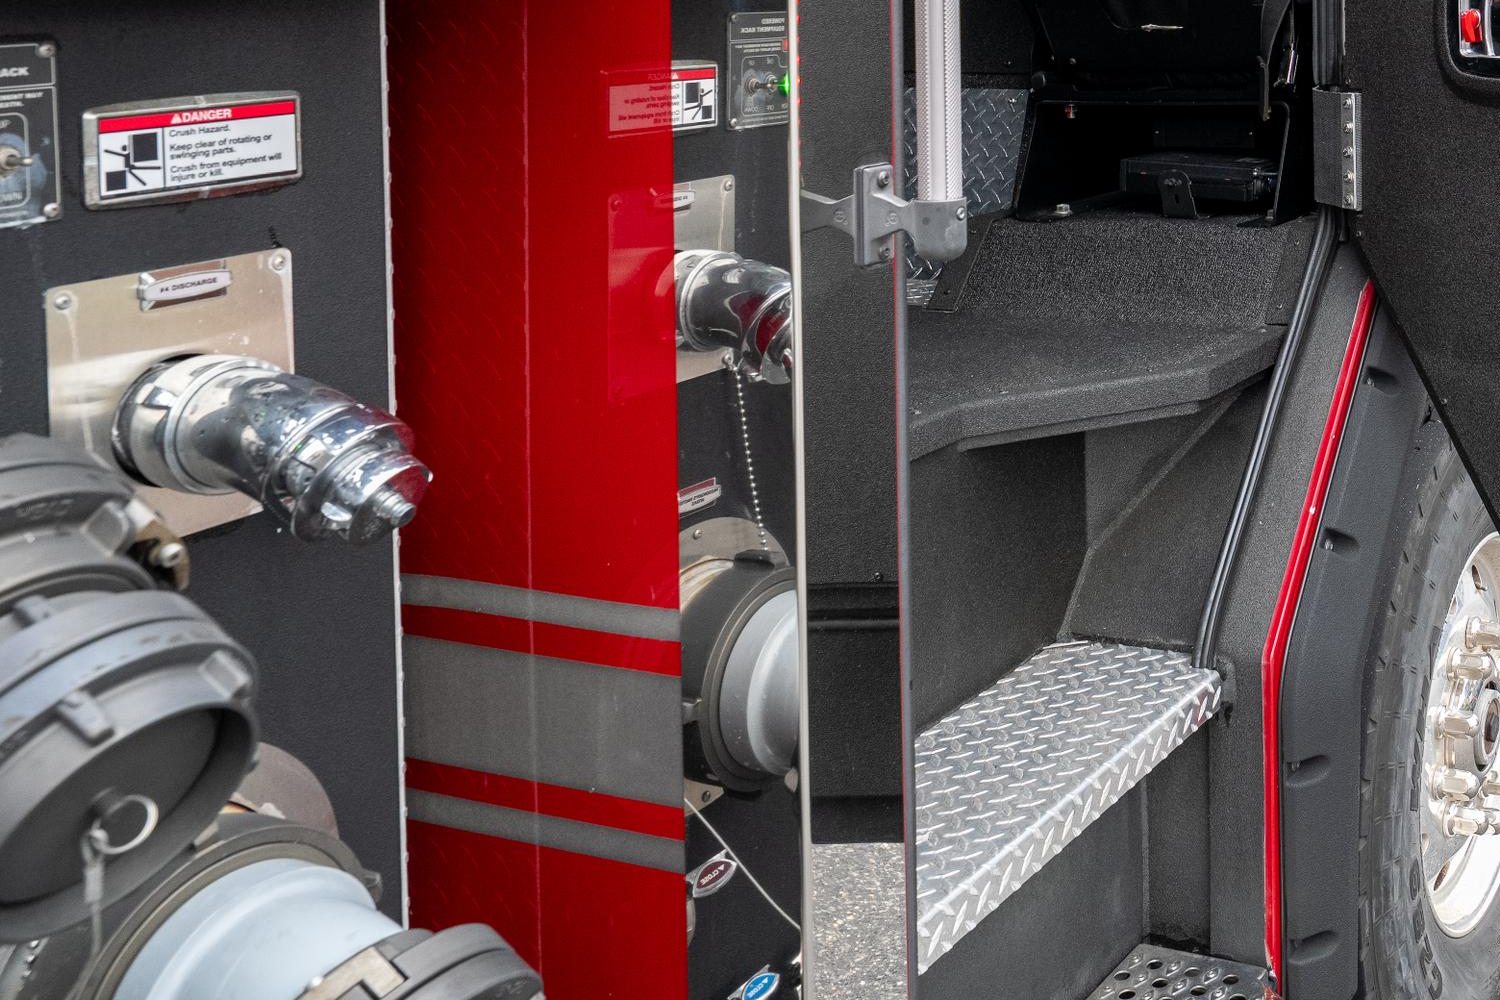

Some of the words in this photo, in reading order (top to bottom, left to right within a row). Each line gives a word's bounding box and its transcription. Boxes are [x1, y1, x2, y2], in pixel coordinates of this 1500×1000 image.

[181, 108, 232, 122] DANGER
[169, 128, 196, 137] Crush
[199, 124, 231, 134] Hazard.
[169, 143, 192, 151] Keep
[195, 140, 216, 148] clear
[218, 138, 227, 146] of
[229, 135, 262, 145] rotating
[170, 149, 210, 160] swinging
[212, 147, 236, 157] parts.
[170, 164, 197, 173] Crush
[200, 161, 220, 169] from
[222, 155, 266, 167] equipment
[268, 152, 282, 160] will
[170, 171, 196, 182] injure
[209, 168, 224, 177] kill.
[171, 277, 218, 291] DISCHARGE
